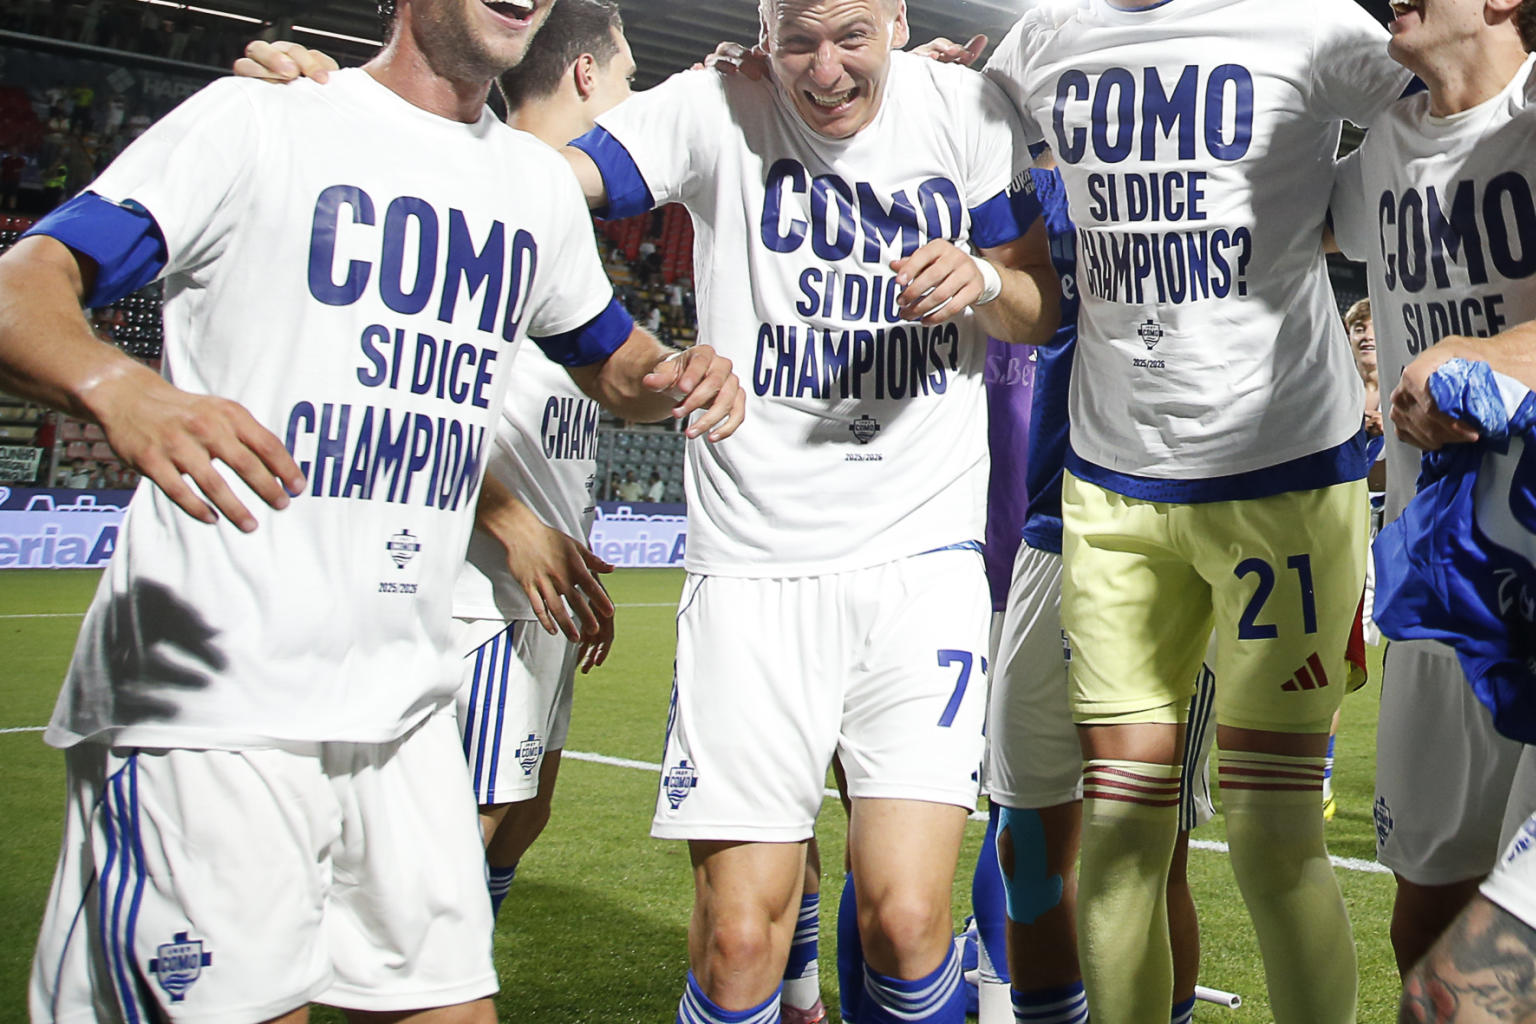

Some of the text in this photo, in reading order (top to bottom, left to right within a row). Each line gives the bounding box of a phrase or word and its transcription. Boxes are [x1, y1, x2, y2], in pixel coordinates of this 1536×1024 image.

[1053, 64, 1254, 164] COMO
[761, 158, 962, 263] COMO
[1087, 171, 1207, 222] SI DICE
[308, 184, 538, 343] COMO
[796, 267, 905, 323] SI DIC
[1079, 226, 1252, 305] CHAMPIONS?
[356, 323, 498, 409] SI DICE
[753, 322, 960, 400] CHAMPIONS?
[1402, 303, 1428, 356] SI
[1233, 554, 1317, 640] 21
